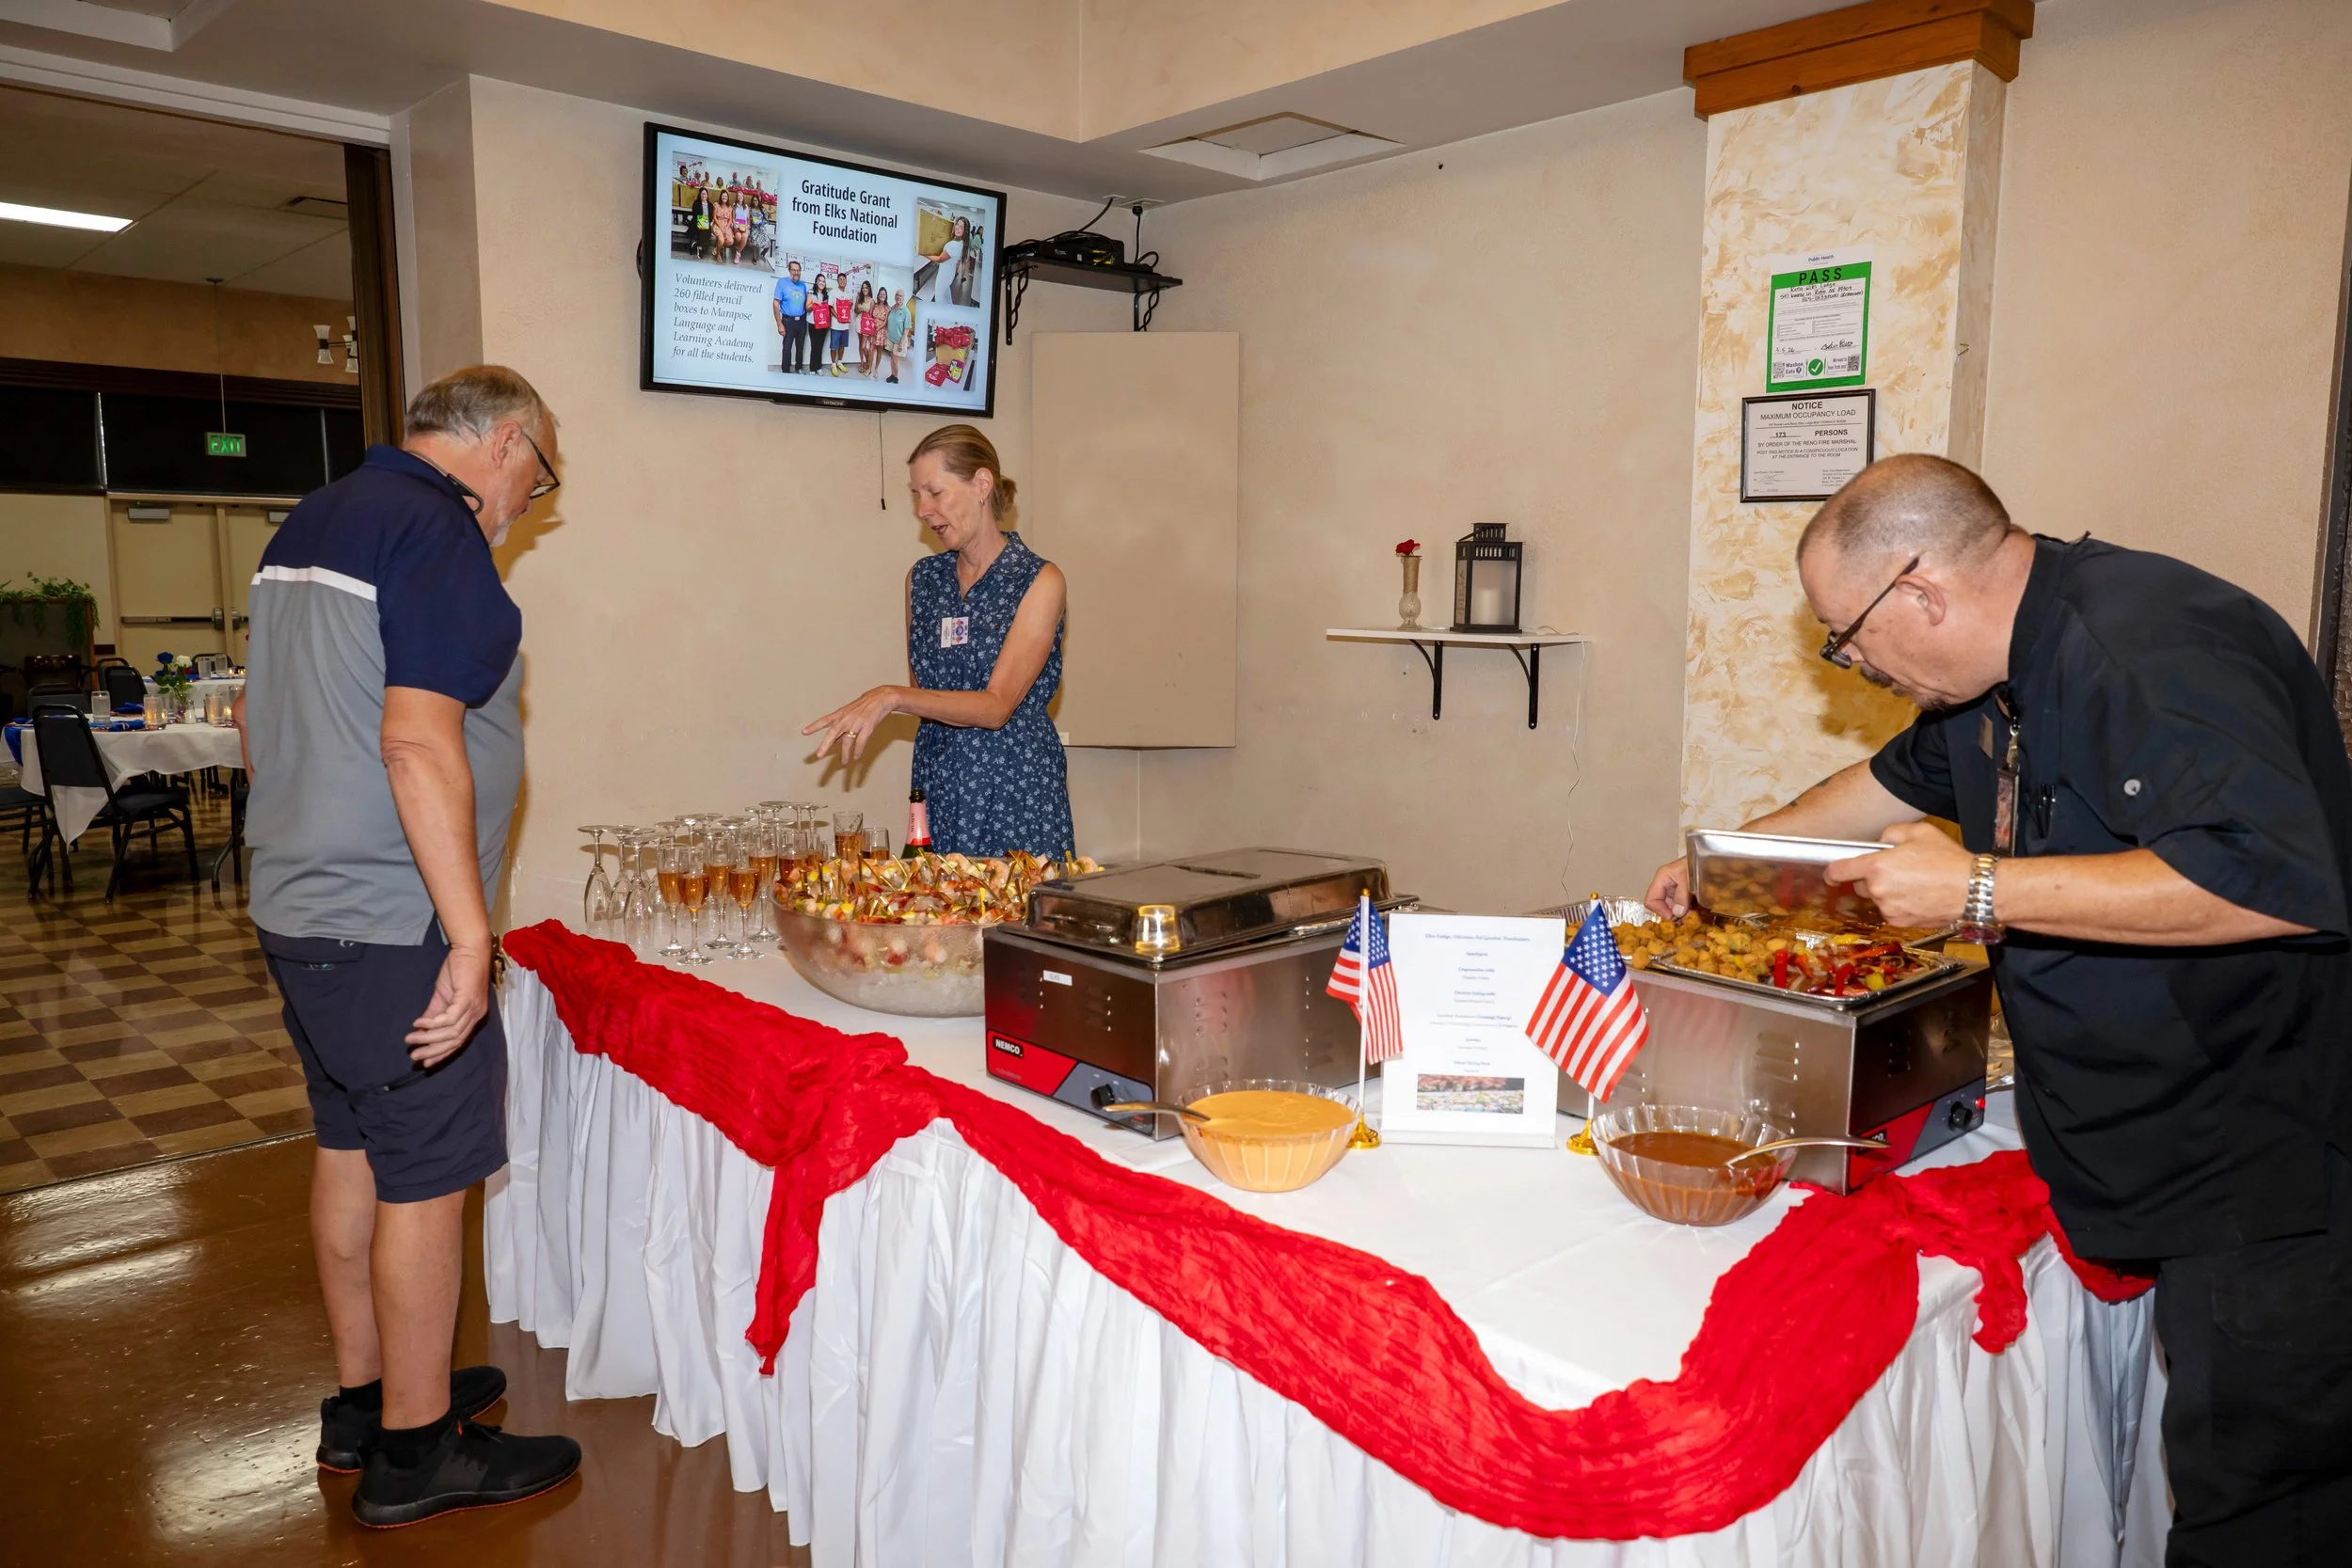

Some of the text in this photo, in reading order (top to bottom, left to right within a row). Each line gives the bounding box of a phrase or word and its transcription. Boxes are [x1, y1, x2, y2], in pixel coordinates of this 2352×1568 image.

[802, 180, 890, 208] Gratitude Grant
[792, 197, 897, 228] from Elks National
[813, 221, 877, 244] Foundation
[675, 273, 762, 293] Volunteers delivered
[1799, 268, 1842, 285] PASS
[674, 288, 742, 305] 260 filled pencil
[674, 302, 752, 321] boxes to Marapose
[674, 317, 734, 333] Language and
[674, 331, 754, 351] Learning Academy
[672, 346, 754, 363] for all the students.
[1792, 402, 1823, 410] NOTICE
[211, 436, 242, 454] EXIT
[995, 1039, 1020, 1054] NEMCO
